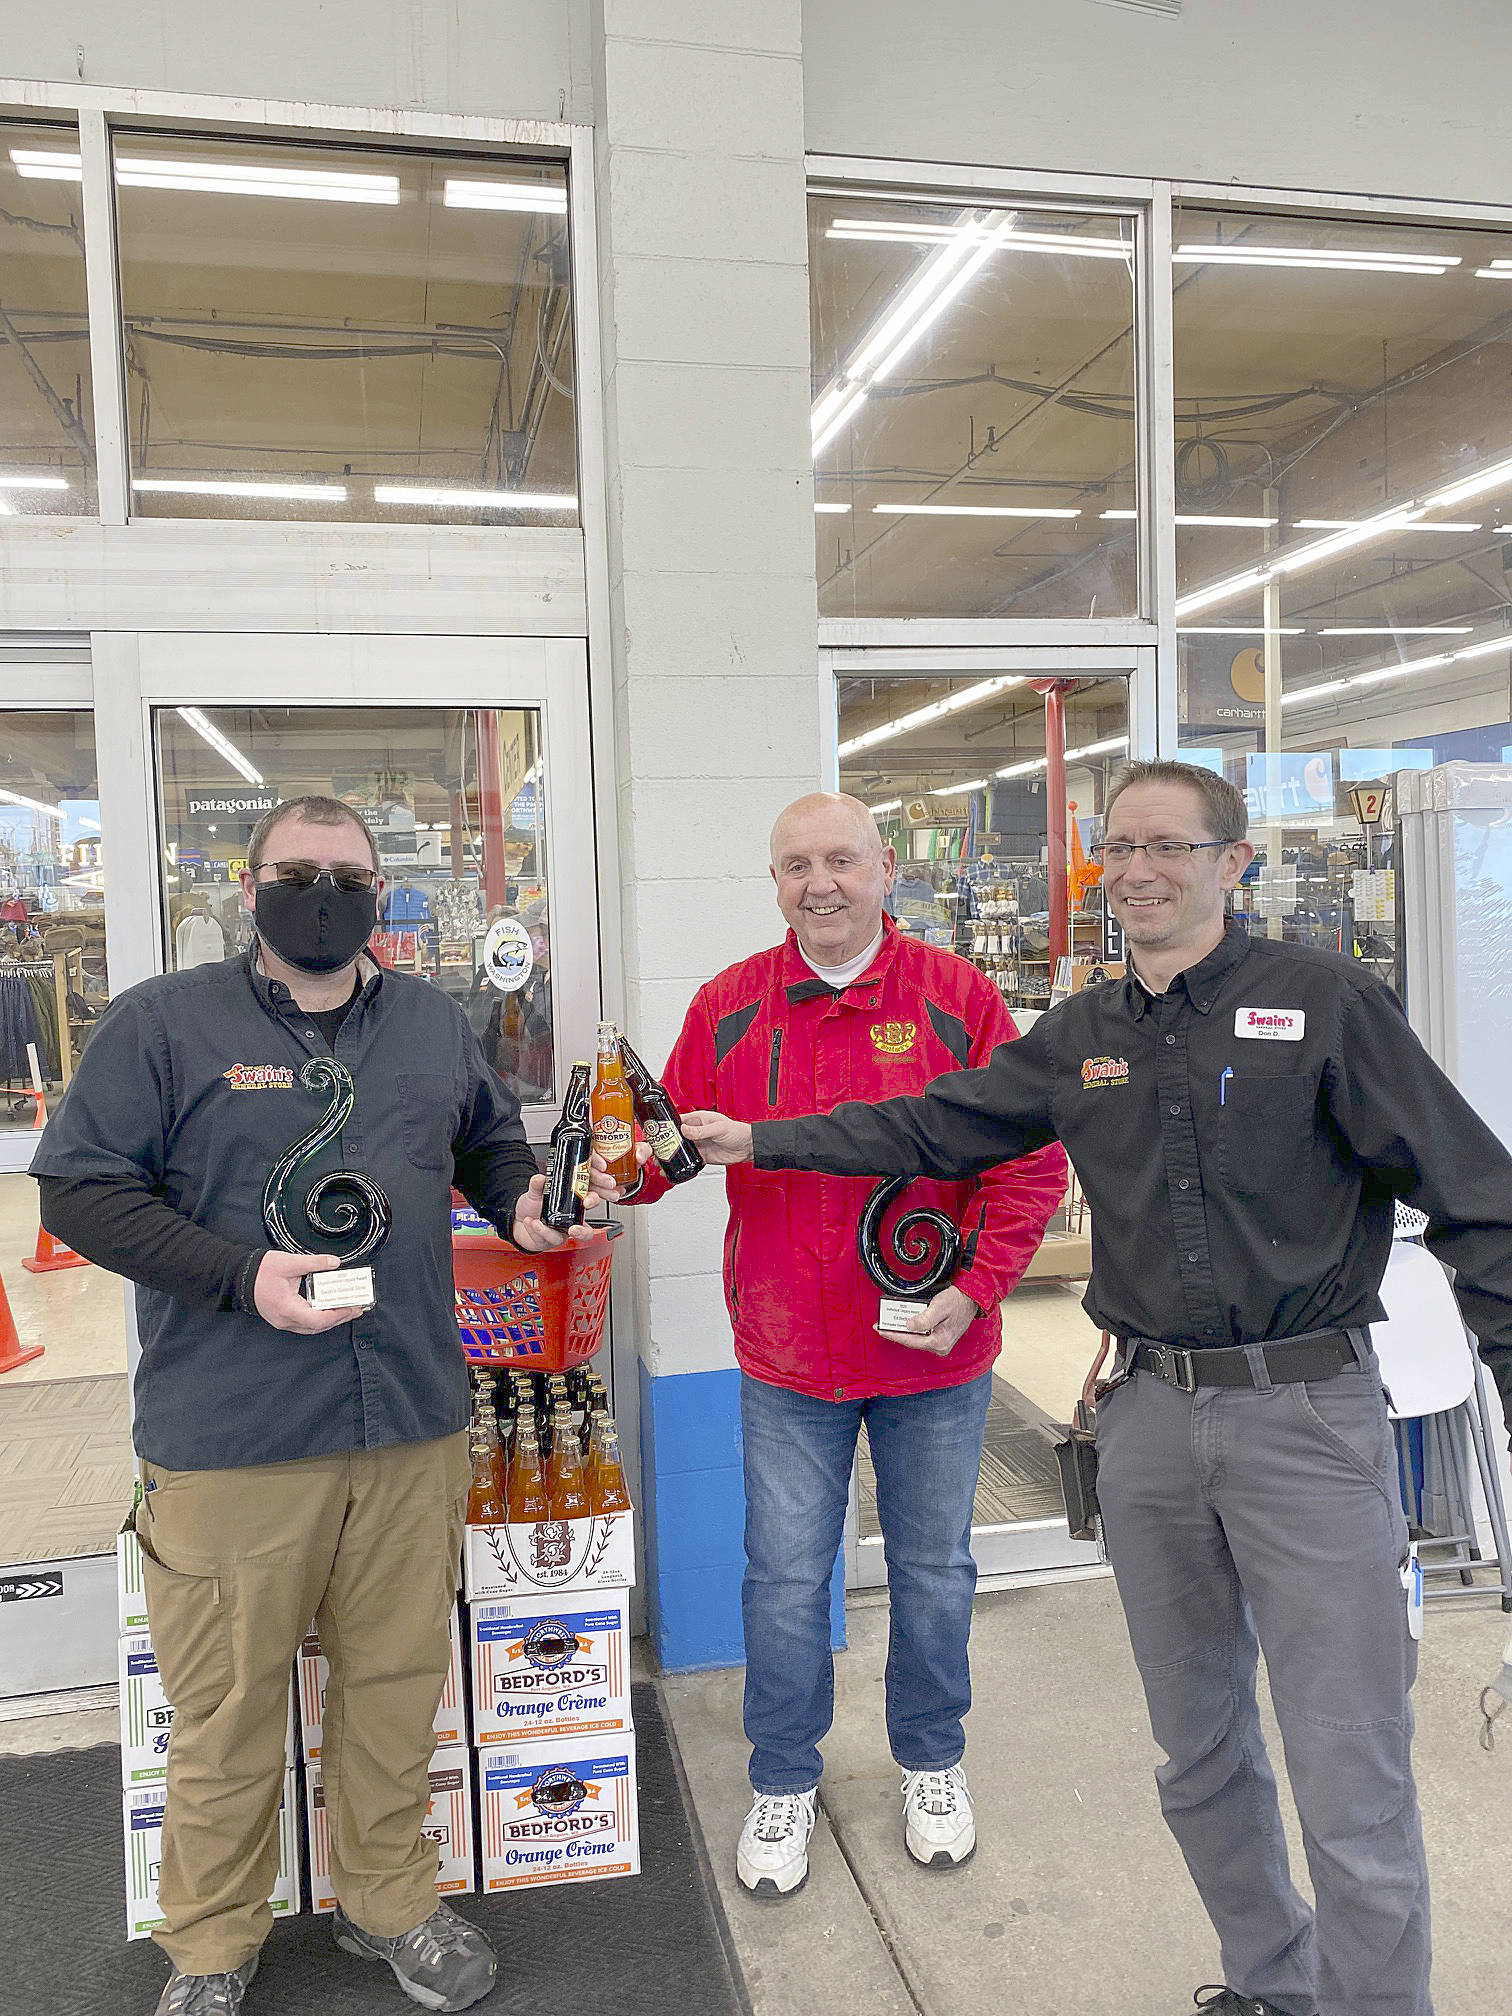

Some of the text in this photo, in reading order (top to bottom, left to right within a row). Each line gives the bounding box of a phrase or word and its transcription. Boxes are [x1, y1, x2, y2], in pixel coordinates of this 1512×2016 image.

[1216, 708, 1266, 719] carhartt
[189, 797, 273, 814] patagonia
[1367, 795, 1377, 814] 2
[494, 926, 520, 937] FISH
[486, 961, 531, 984] WASHINGTON
[1247, 1011, 1294, 1027] Swain's
[229, 1063, 294, 1084] Swain's
[1081, 1057, 1129, 1082] Swain's
[268, 1081, 293, 1089] STORE
[536, 1569, 568, 1579] est. 1984
[500, 1669, 600, 1690] BEDFORD'S
[496, 1693, 607, 1718] Orange Crème
[521, 1727, 559, 1737] WONDERFUL
[559, 1724, 589, 1733] BEVERAGE
[508, 1814, 609, 1838] BEDFORD'S
[505, 1840, 615, 1865] Orange Crème
[530, 1872, 567, 1882] WONDERFUL
[567, 1869, 597, 1878] BEVERAGE
